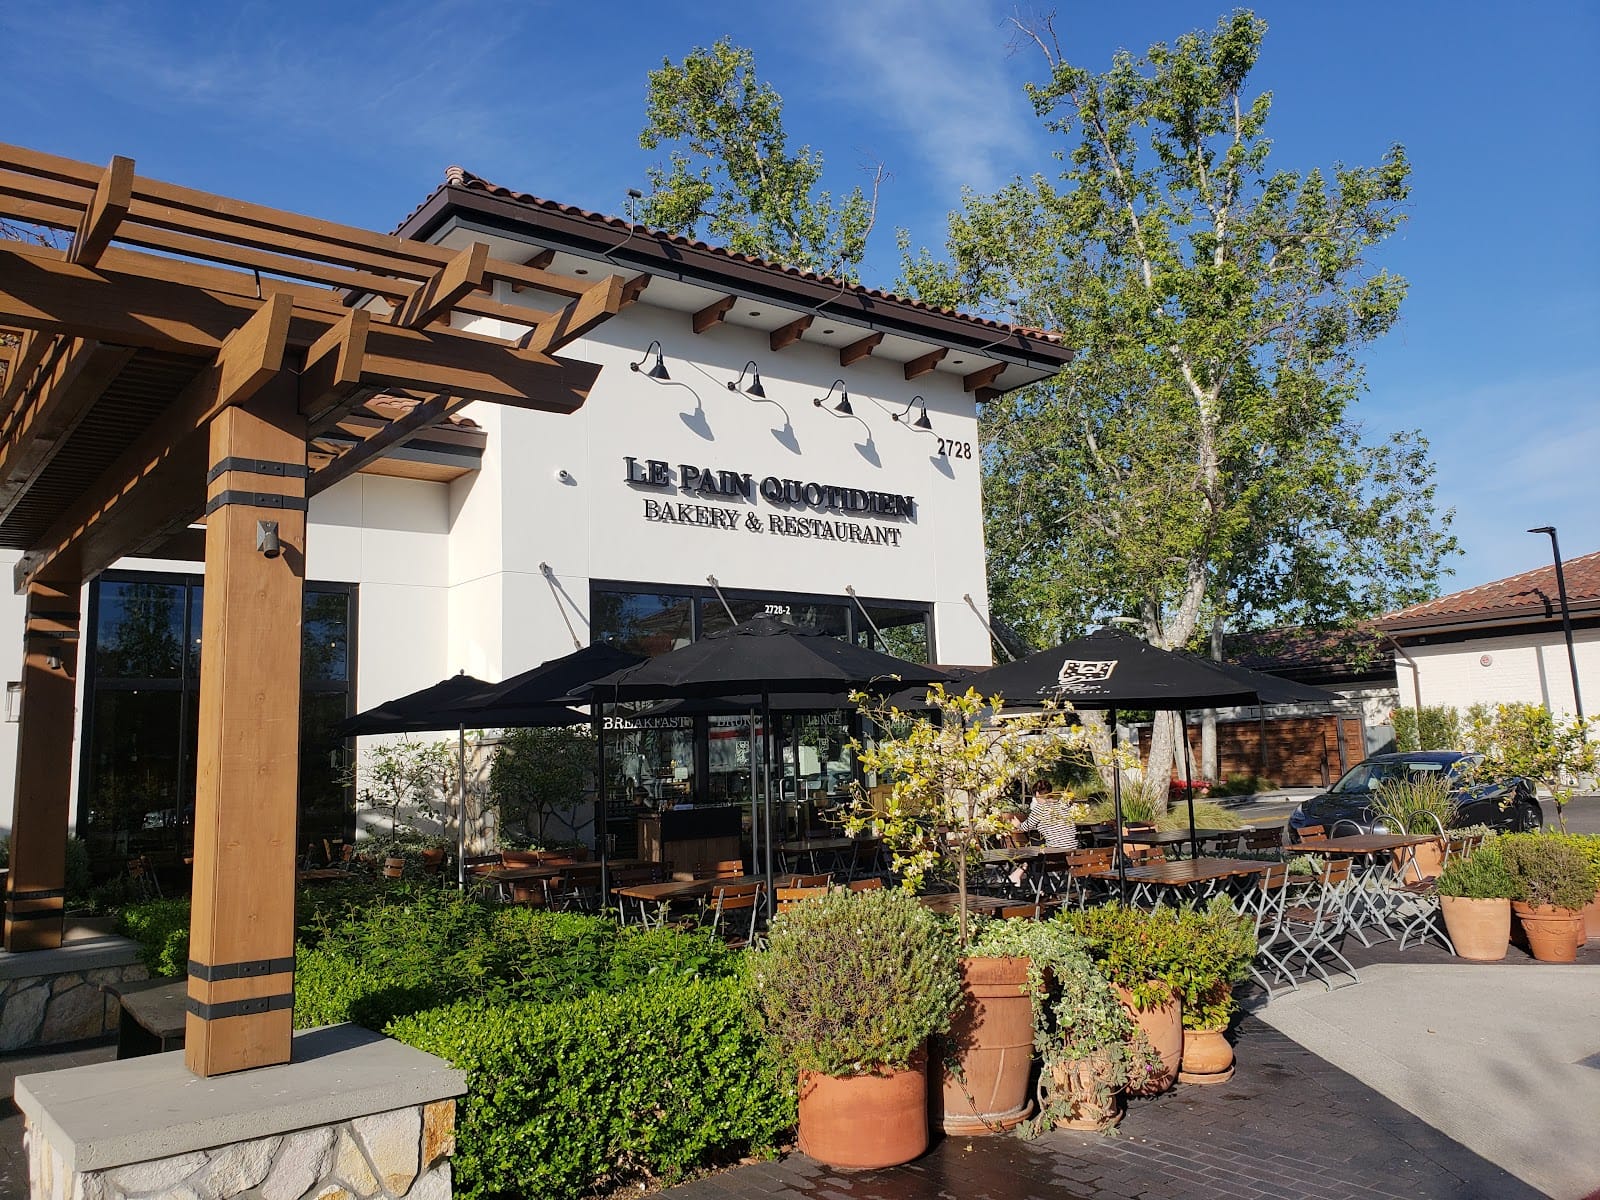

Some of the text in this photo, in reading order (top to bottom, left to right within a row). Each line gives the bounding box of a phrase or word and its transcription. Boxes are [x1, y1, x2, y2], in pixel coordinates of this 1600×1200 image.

[937, 438, 972, 459] 2728
[623, 456, 914, 518] LE PAIN QUOTIDIEN
[643, 498, 902, 547] BAKERY & RESTAURANT
[764, 604, 791, 615] 2728-2
[602, 716, 686, 730] BREAKFAST
